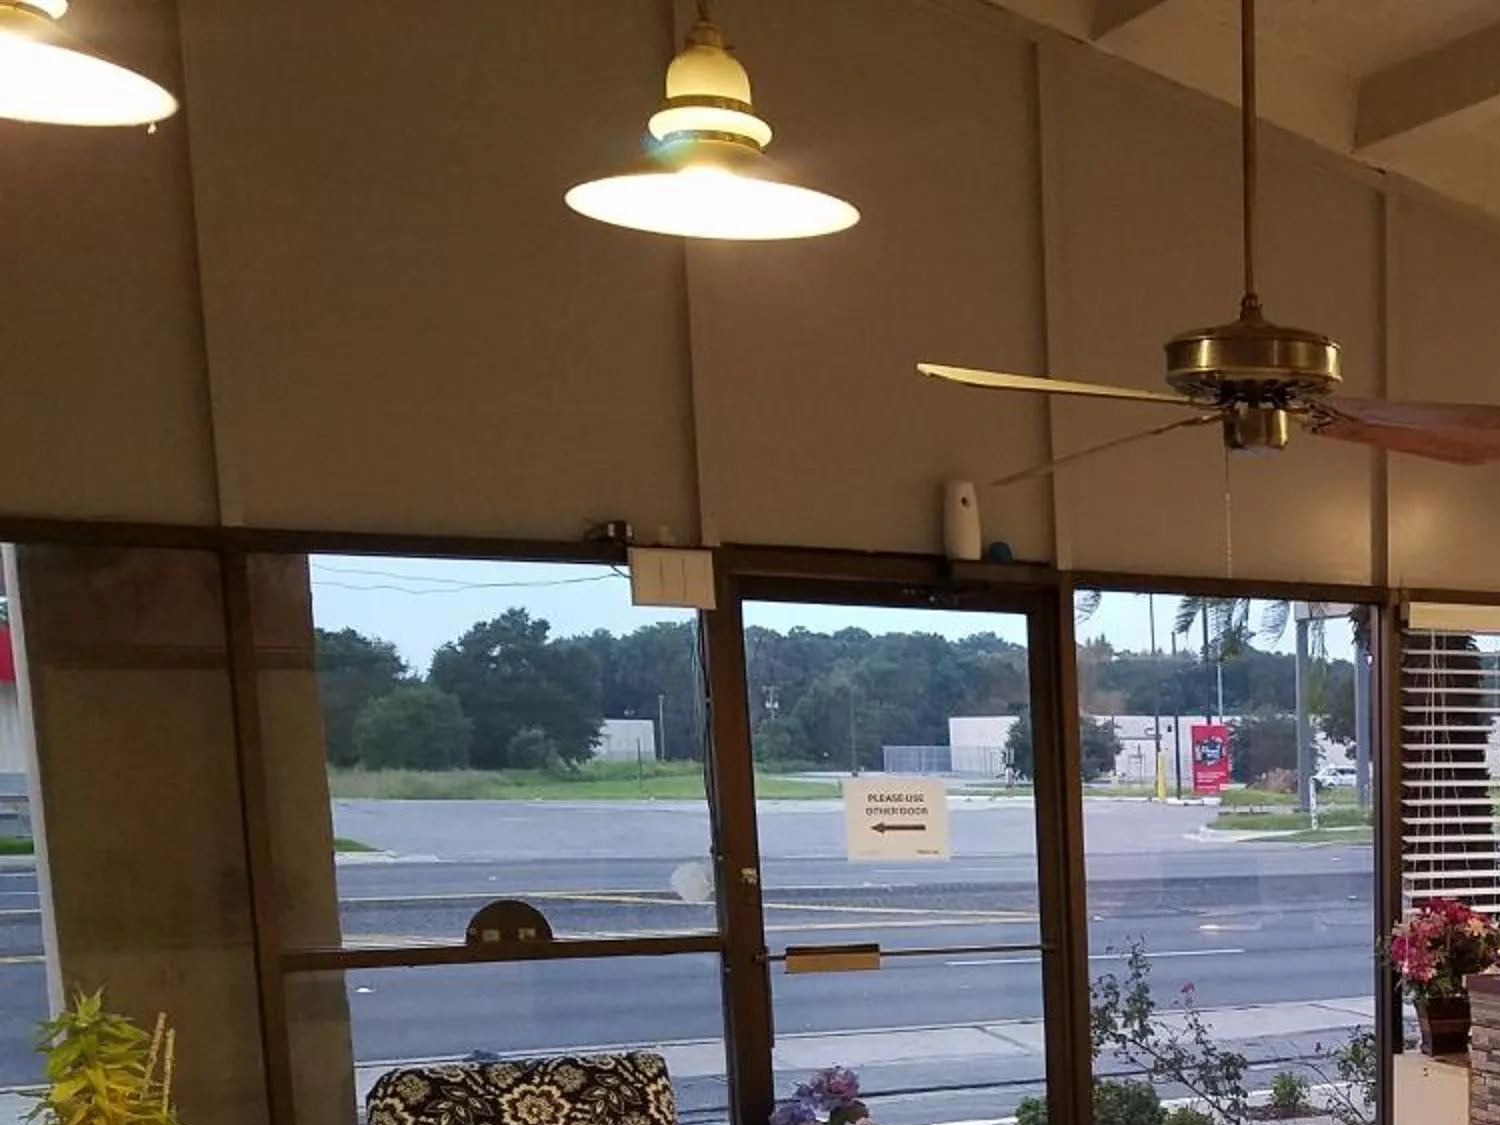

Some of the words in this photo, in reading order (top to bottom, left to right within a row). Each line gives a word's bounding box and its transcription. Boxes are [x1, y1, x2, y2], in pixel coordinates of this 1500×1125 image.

[867, 793, 903, 803] PLEASE
[905, 793, 924, 803] USE
[865, 807, 898, 816] OTHER
[899, 807, 928, 815] DOOR
